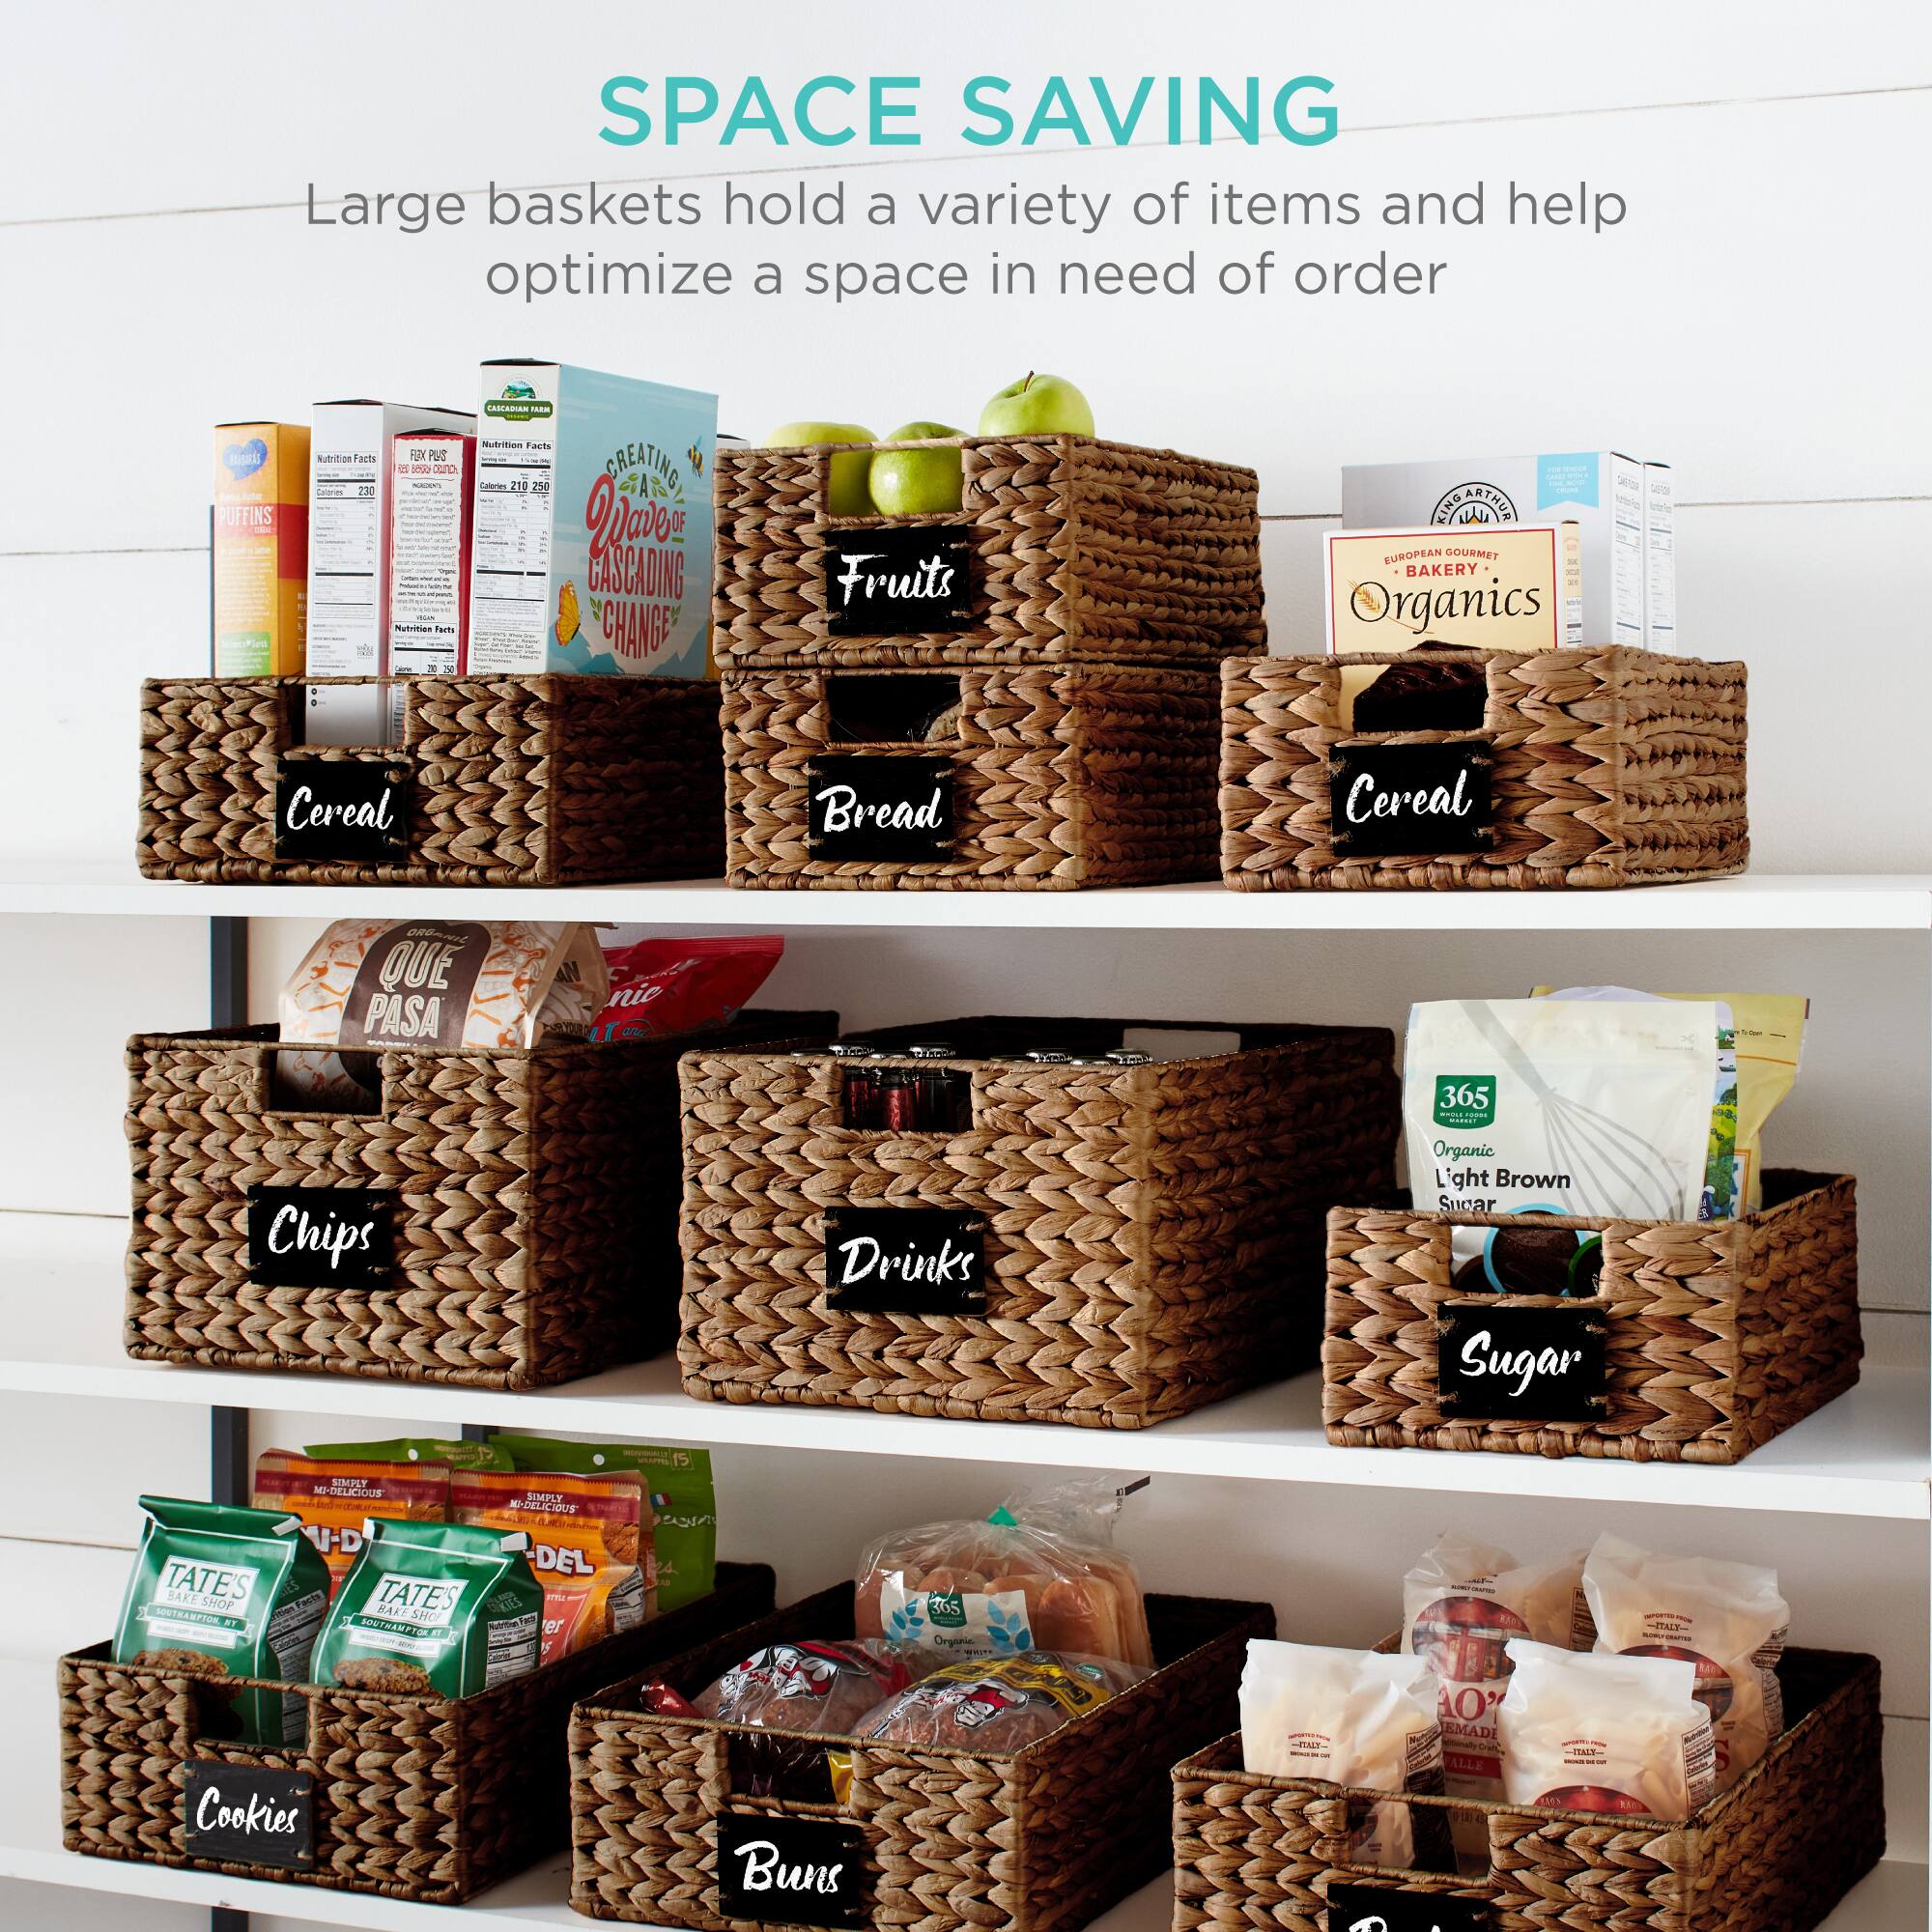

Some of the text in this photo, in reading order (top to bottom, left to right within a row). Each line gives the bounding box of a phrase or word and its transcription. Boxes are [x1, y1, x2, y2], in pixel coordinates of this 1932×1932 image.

[482, 440, 552, 450] Nutrition Facts
[317, 453, 377, 464] Nutrition Facts
[428, 448, 447, 462] PLUS
[606, 442, 679, 490] CREATING
[316, 486, 375, 497] Calories 230
[510, 480, 527, 491] 210
[532, 481, 550, 491] 250
[639, 472, 649, 498] A
[219, 505, 272, 526] PUFFINS
[585, 473, 687, 560] Wave OF
[1436, 488, 1512, 526] KING ARTHUR
[1384, 548, 1499, 565] EUROPEAN GOURMET
[588, 543, 685, 600] CASCADING
[1406, 562, 1478, 578] BAKERY
[838, 554, 955, 607] Fruits
[1350, 577, 1541, 635] Organics
[394, 624, 455, 634] Nutrition Facts
[603, 599, 671, 660] CHANGE
[443, 665, 455, 674] 250
[1346, 769, 1473, 824] Cereal
[287, 785, 394, 831] Cereal
[815, 785, 943, 833] Bread
[364, 992, 441, 1039] PASA
[1439, 1082, 1490, 1110] 365
[1434, 1139, 1495, 1162] Organic
[1435, 1167, 1571, 1192] Light Brown
[1438, 1194, 1497, 1213] Sugar
[269, 1204, 375, 1269] Chips
[838, 1236, 975, 1286] Drinks
[1459, 1330, 1582, 1397] Sugar
[331, 1478, 368, 1488] SIMPLY
[526, 1492, 563, 1503] SIMPLY
[525, 1544, 595, 1575] -DEL
[166, 1562, 250, 1601] TATE'S
[1471, 1585, 1496, 1594] CRAFTED
[167, 1591, 235, 1611] BAKE SHOP
[295, 1592, 322, 1609] Facts
[378, 1579, 459, 1610] TATE'S
[546, 1593, 566, 1602] STYLE
[377, 1604, 442, 1623] BAKE SHOP
[929, 1600, 960, 1616] 365
[1643, 1611, 1693, 1624] IMPORTED FROM
[489, 1614, 536, 1632] Nutrition Facts
[1655, 1621, 1681, 1632] ITALY
[934, 1634, 975, 1649] Organic
[1664, 1634, 1692, 1642] CRAFTED
[488, 1652, 511, 1662] Calories
[1437, 1684, 1507, 1721] AO'
[1316, 1733, 1331, 1742] FROM
[1441, 1721, 1498, 1740] EMADE
[1684, 1725, 1710, 1746] Nutrition
[1299, 1741, 1321, 1749] ITALY
[1561, 1739, 1607, 1748] IMPORTED FROM
[1573, 1747, 1597, 1756] ITALY
[1687, 1762, 1709, 1776] Calories
[196, 1786, 298, 1835] Cookies
[734, 1840, 844, 1894] Buns
